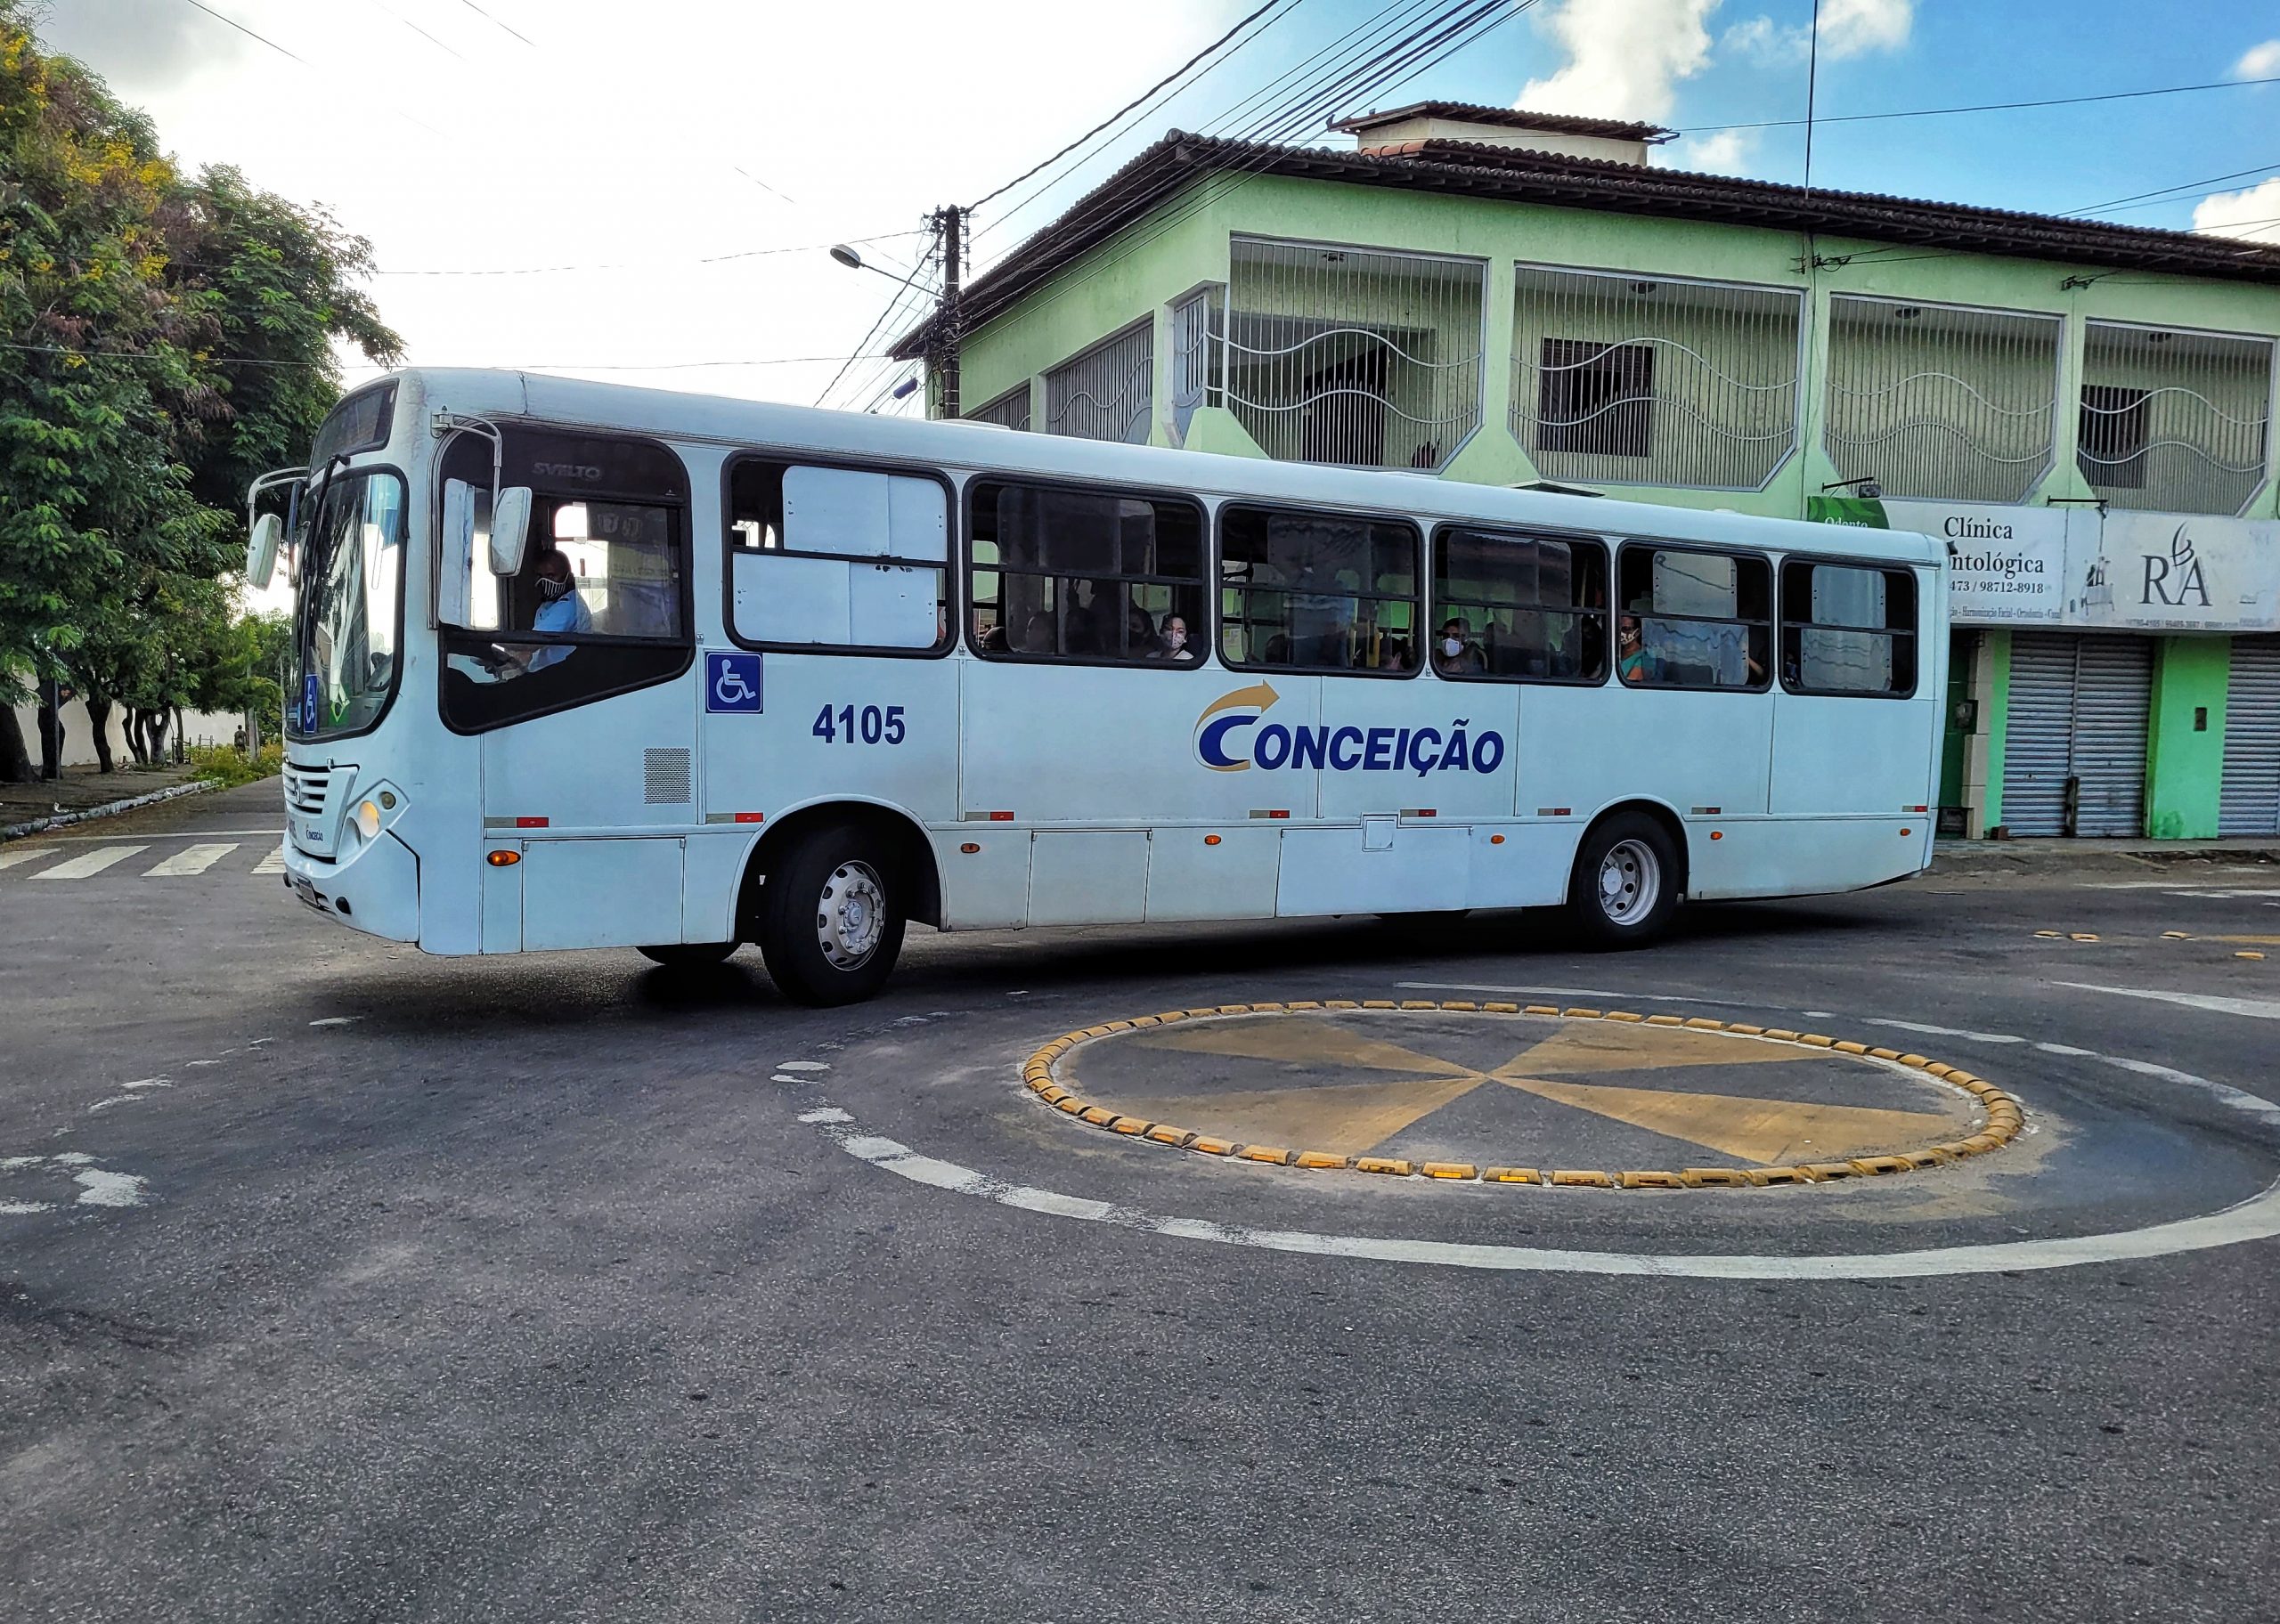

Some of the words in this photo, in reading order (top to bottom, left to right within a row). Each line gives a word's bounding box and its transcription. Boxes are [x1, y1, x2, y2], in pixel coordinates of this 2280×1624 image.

[533, 462, 601, 480] SVELTO
[1944, 516, 2014, 540] Clínica
[1949, 551, 2045, 580] ntológica
[1980, 581, 2044, 594] 98712-8918
[811, 703, 907, 745] 4105
[1199, 714, 1505, 778] CONCEIÇÃO
